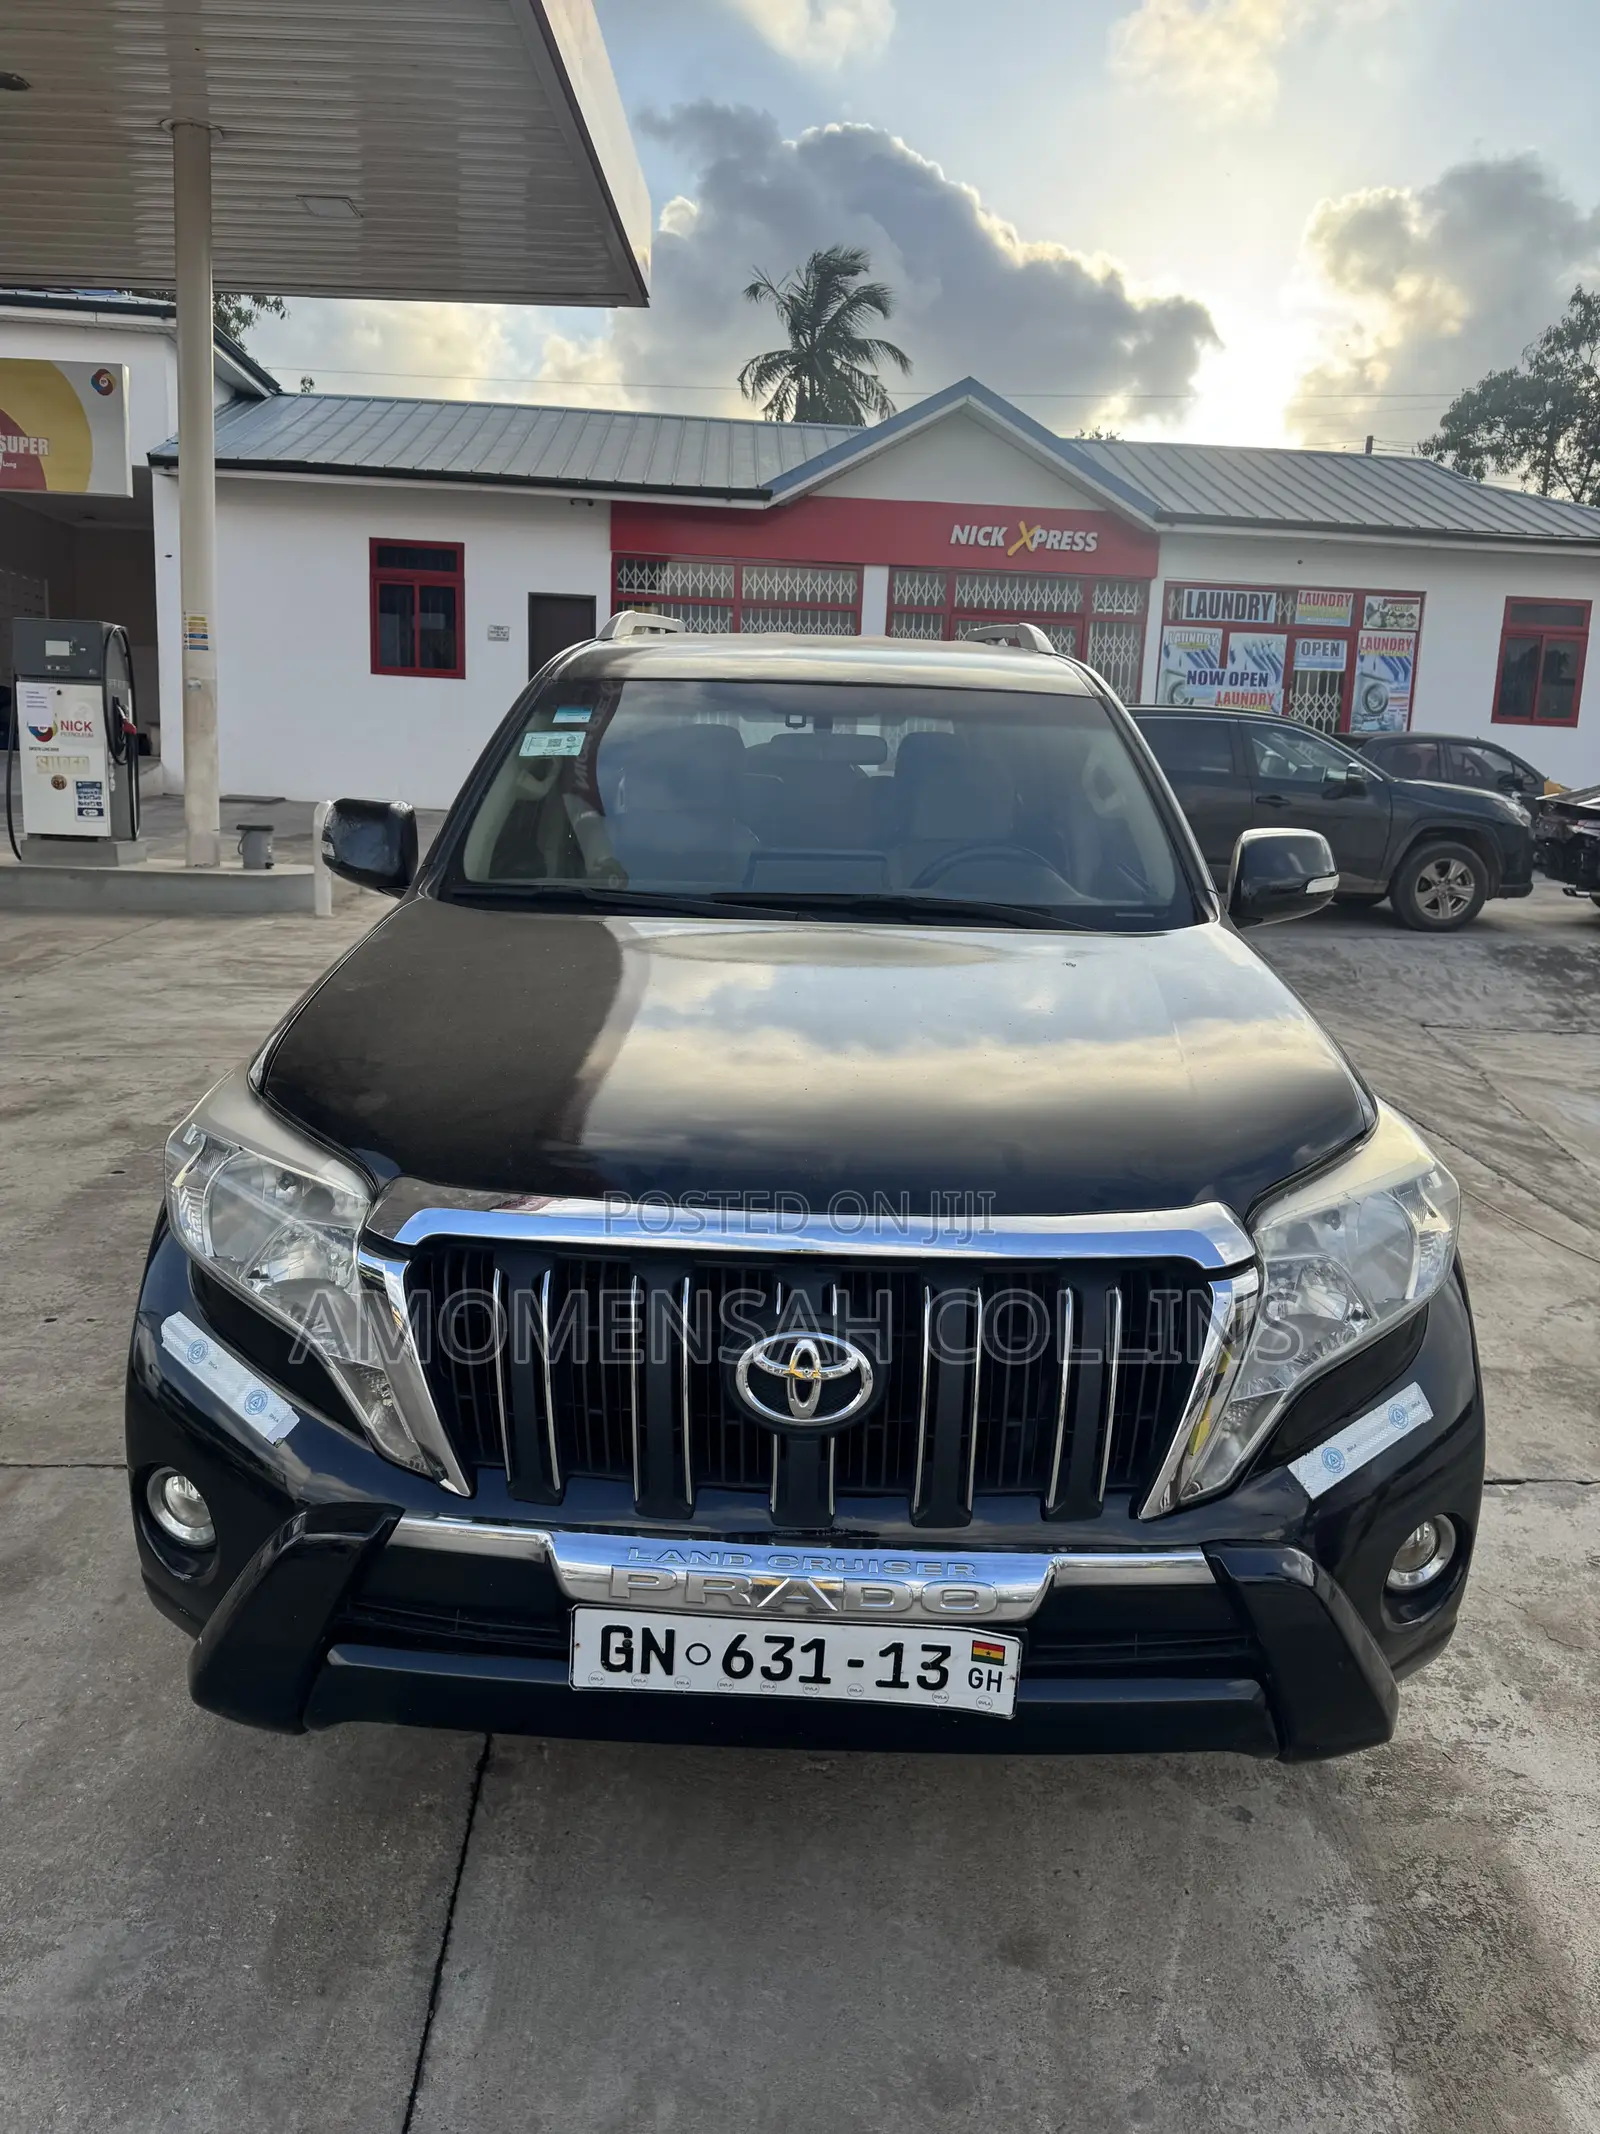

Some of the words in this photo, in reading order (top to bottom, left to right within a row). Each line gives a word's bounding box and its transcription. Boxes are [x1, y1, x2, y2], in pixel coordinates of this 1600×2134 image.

[950, 524, 1008, 547] NICK
[1007, 521, 1098, 556] XPRESS
[1185, 590, 1273, 620] LAUNDRY
[1298, 591, 1353, 607] LAUNDRY
[1168, 631, 1219, 645] LAUNDRY
[1359, 636, 1413, 652] LAUNDRY
[1301, 641, 1340, 657] OPEN
[1187, 670, 1226, 686] NOW
[1228, 671, 1269, 687] OPEN
[1215, 691, 1275, 706] LAUNDRY
[60, 720, 93, 732] NICK
[626, 1546, 753, 1569] LAND
[767, 1553, 977, 1578] CRUISER
[610, 1564, 999, 1614] PRADO
[600, 1624, 675, 1676] GN
[967, 1667, 1003, 1693] GH
